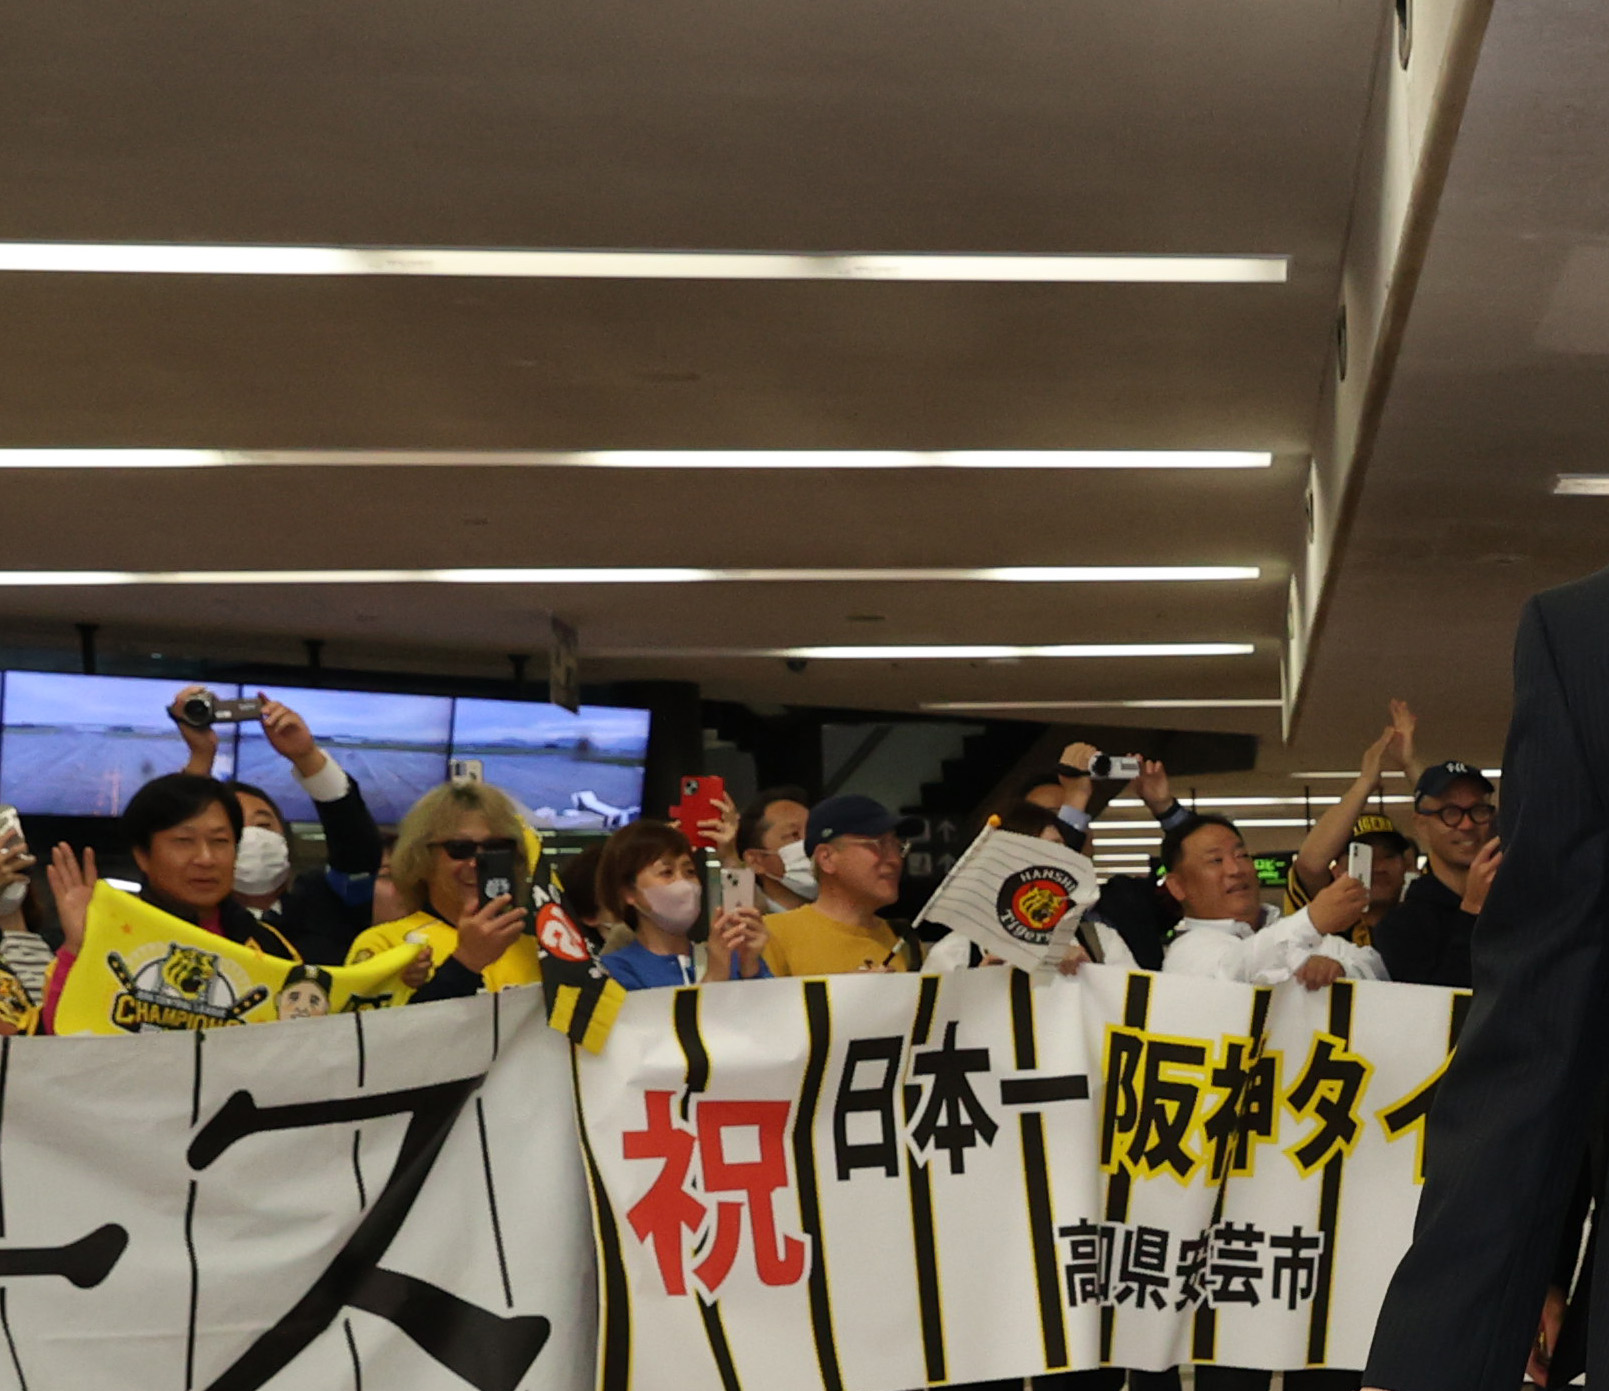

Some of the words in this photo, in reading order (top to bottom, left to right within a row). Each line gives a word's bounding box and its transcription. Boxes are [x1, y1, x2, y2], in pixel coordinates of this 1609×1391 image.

[622, 1090, 805, 1296] 祝
[1058, 1217, 1324, 1313] 高県安芸市
